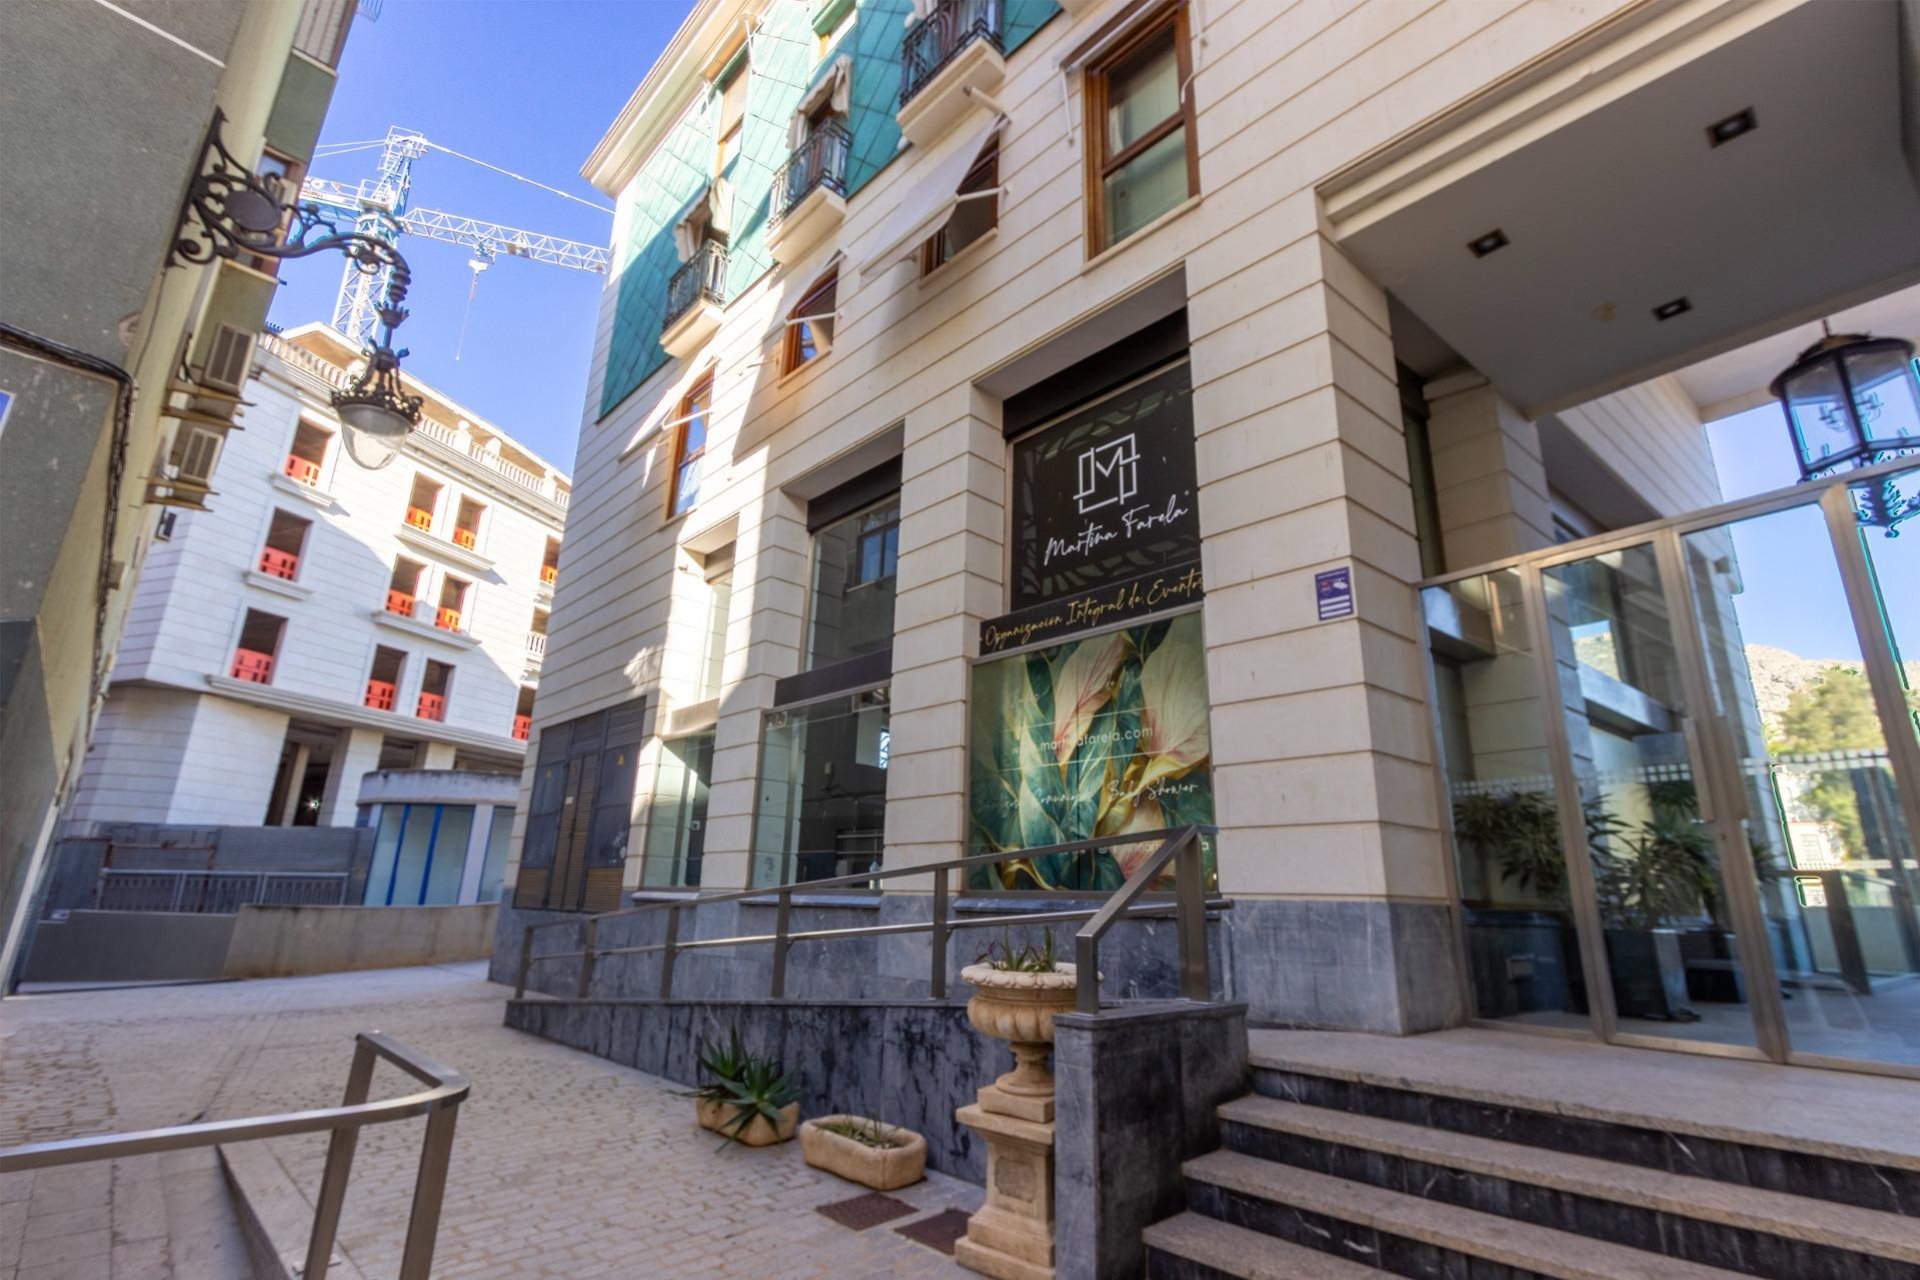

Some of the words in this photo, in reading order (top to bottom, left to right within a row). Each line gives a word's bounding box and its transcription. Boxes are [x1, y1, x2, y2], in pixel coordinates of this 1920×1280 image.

[1043, 522, 1118, 566] Martina
[1121, 494, 1189, 539] Farela
[1066, 587, 1126, 627] Integral
[1128, 582, 1144, 609] de
